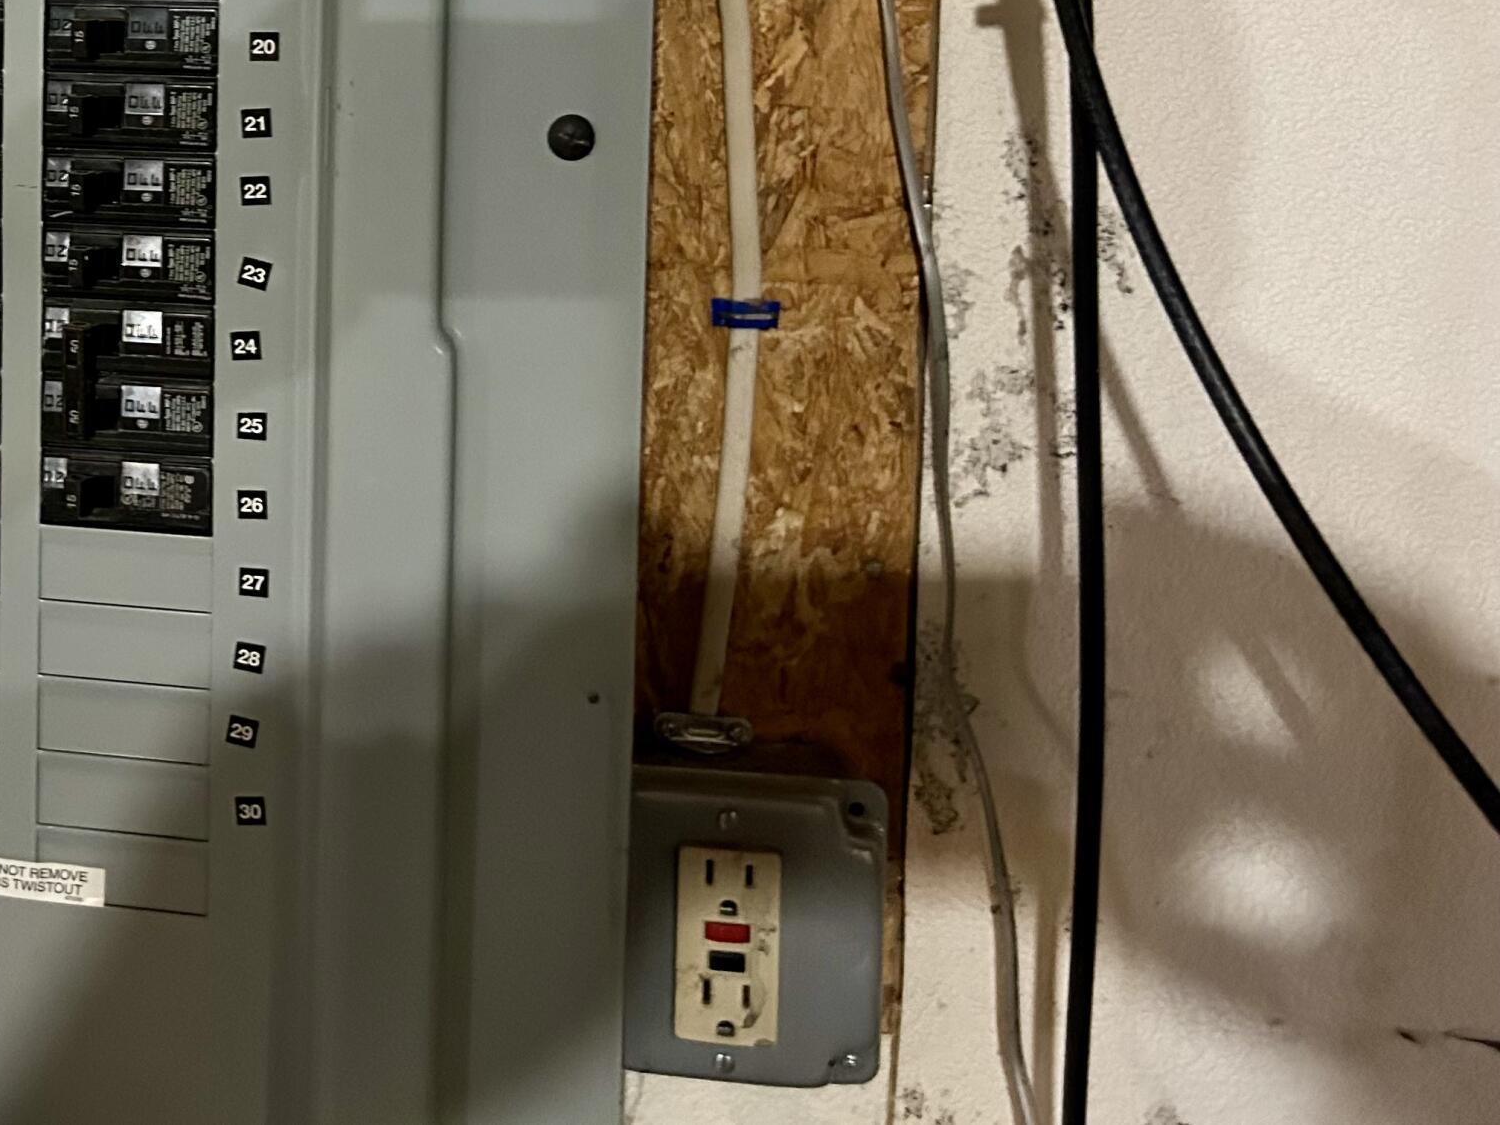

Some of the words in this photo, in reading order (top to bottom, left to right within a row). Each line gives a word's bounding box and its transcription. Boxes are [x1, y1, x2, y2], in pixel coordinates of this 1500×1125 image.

[251, 40, 276, 56] 20
[243, 114, 267, 133] 21
[242, 183, 268, 200] 22
[240, 264, 267, 284] 23
[233, 338, 258, 355] 24
[239, 418, 264, 434] 25
[240, 497, 264, 514] 26
[241, 574, 265, 592] 27
[236, 648, 261, 668] 28
[229, 723, 254, 742] 29
[238, 803, 262, 820] 30
[0, 864, 26, 877] NOT
[29, 867, 89, 883] REMOVE
[13, 878, 83, 896] TWISTOUT
